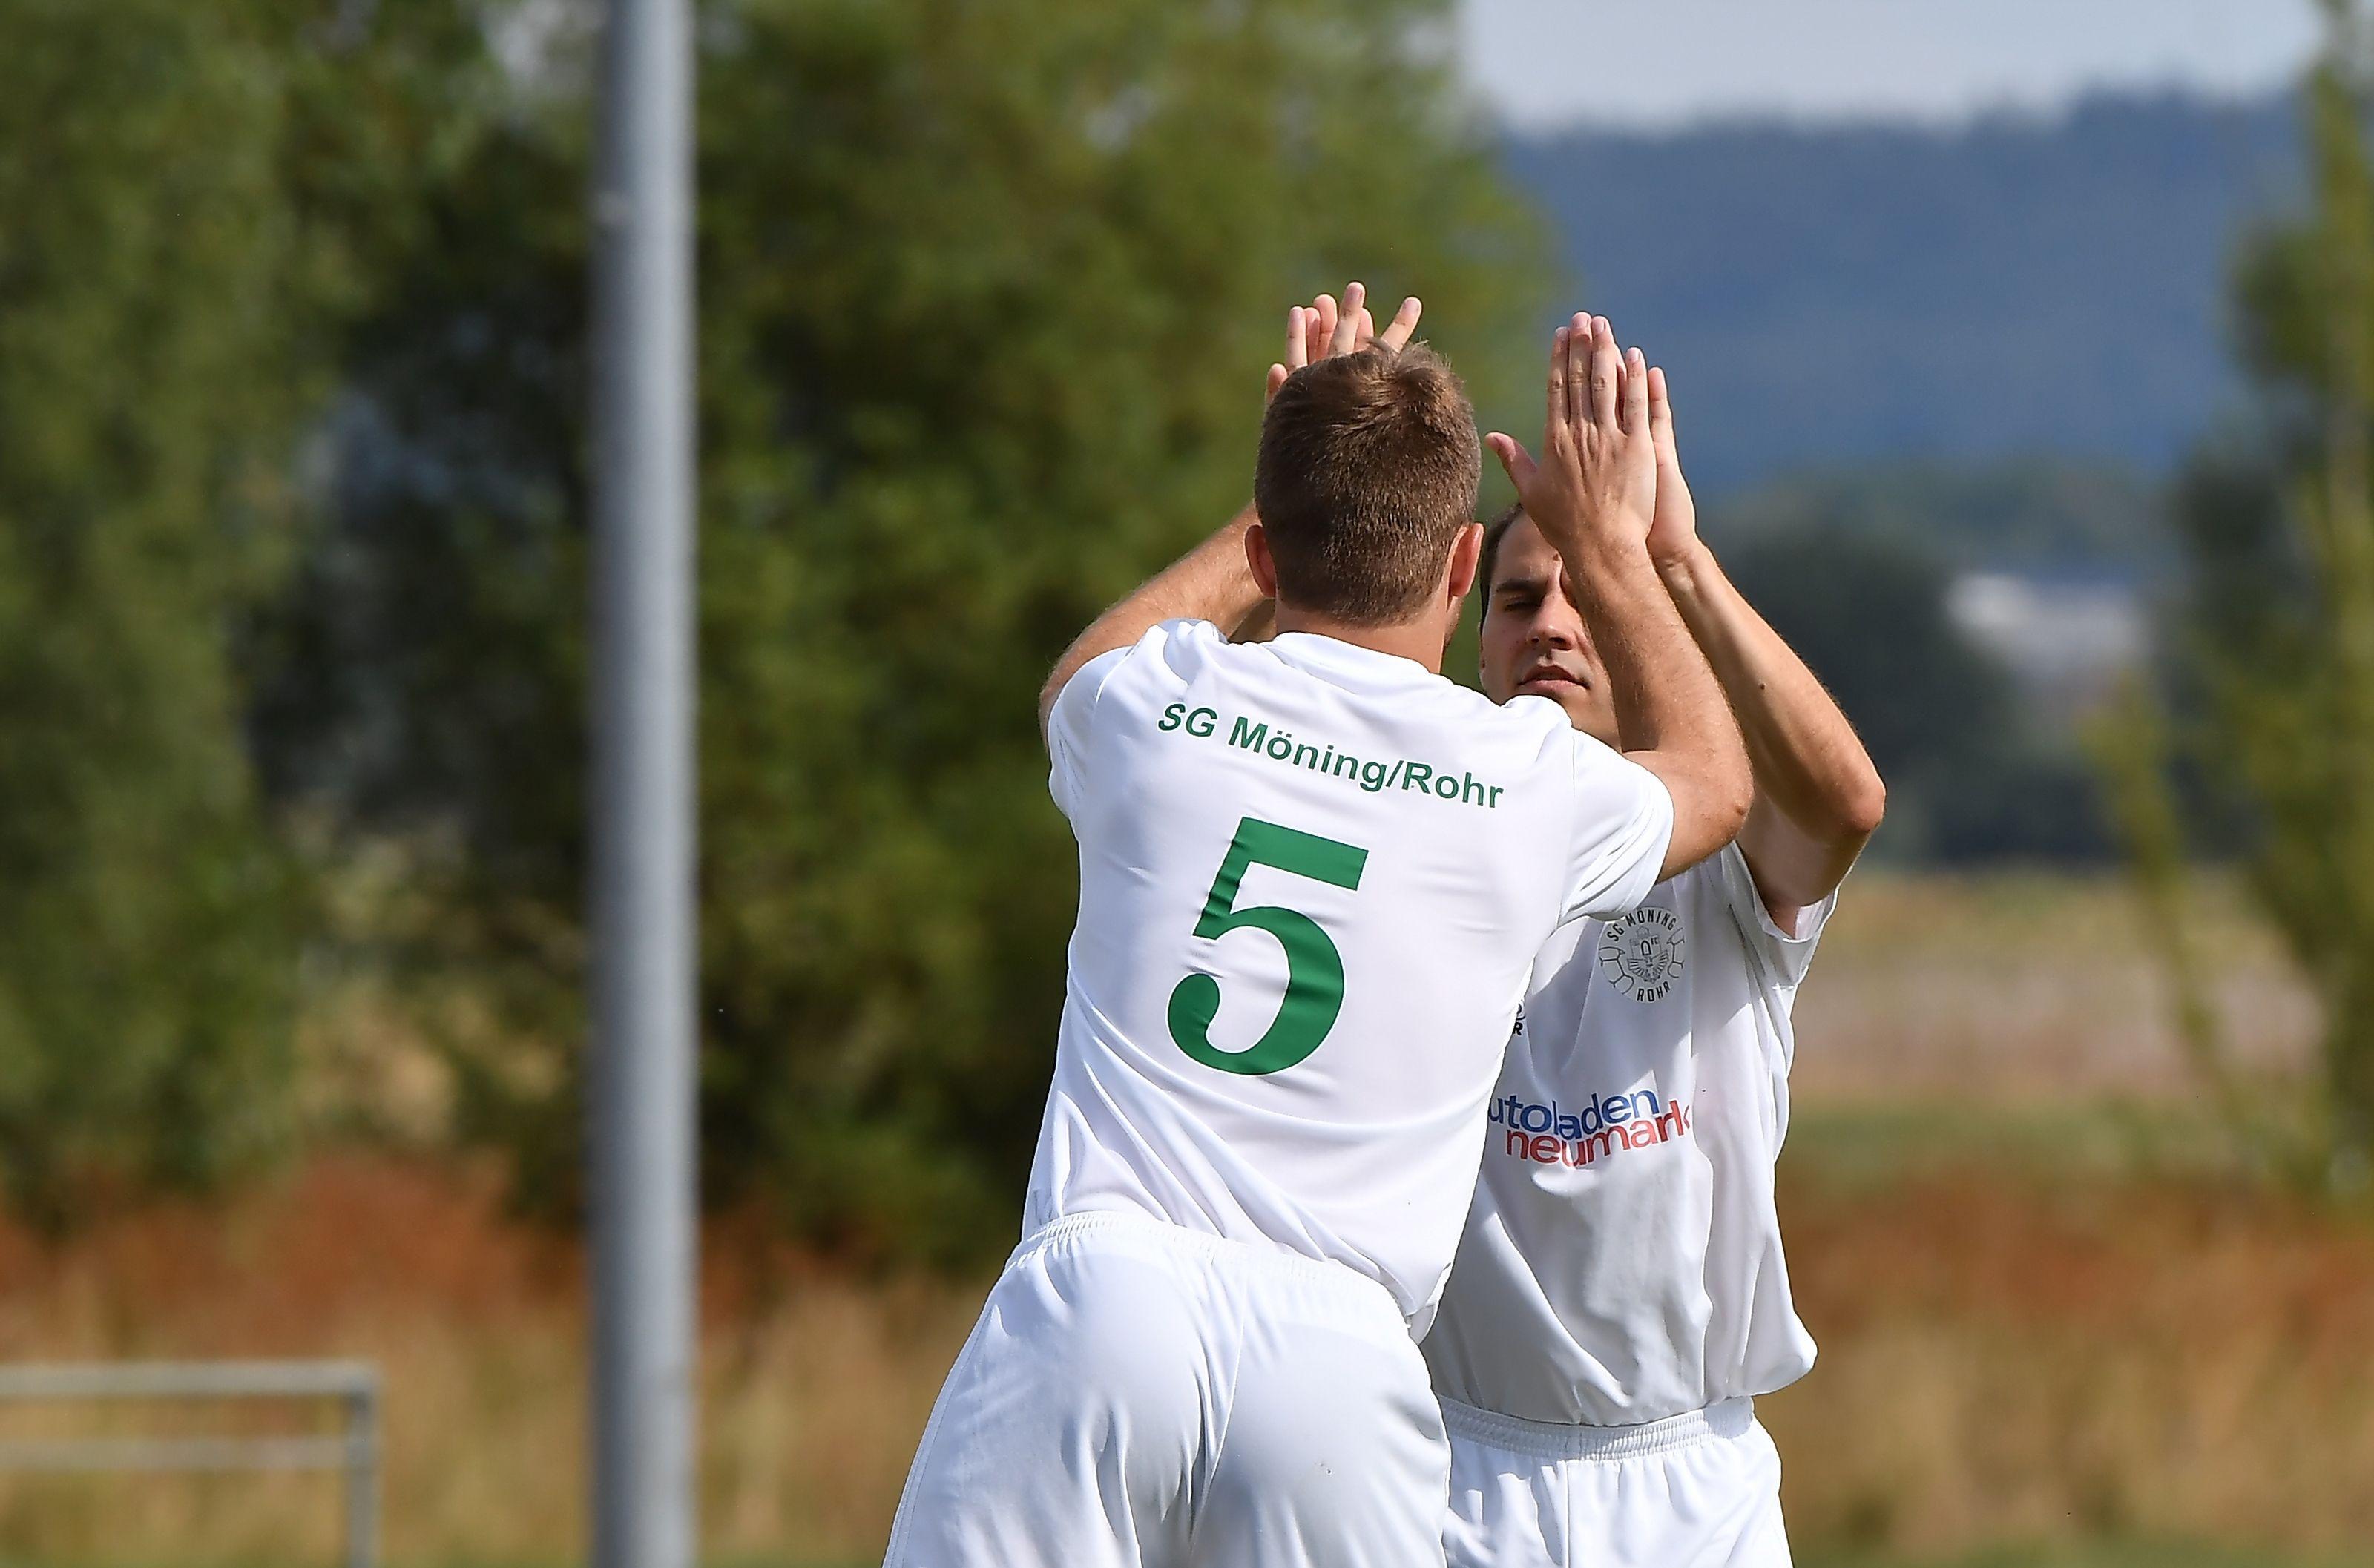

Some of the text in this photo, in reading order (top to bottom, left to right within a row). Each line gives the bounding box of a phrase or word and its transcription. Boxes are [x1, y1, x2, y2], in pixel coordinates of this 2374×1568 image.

[1158, 703, 1504, 808] SG Möning/Rohr
[1167, 817, 1369, 1075] 5
[1606, 923, 1625, 942] SG
[1637, 981, 1671, 1002] ROHR
[1487, 1090, 1660, 1140] utoladen
